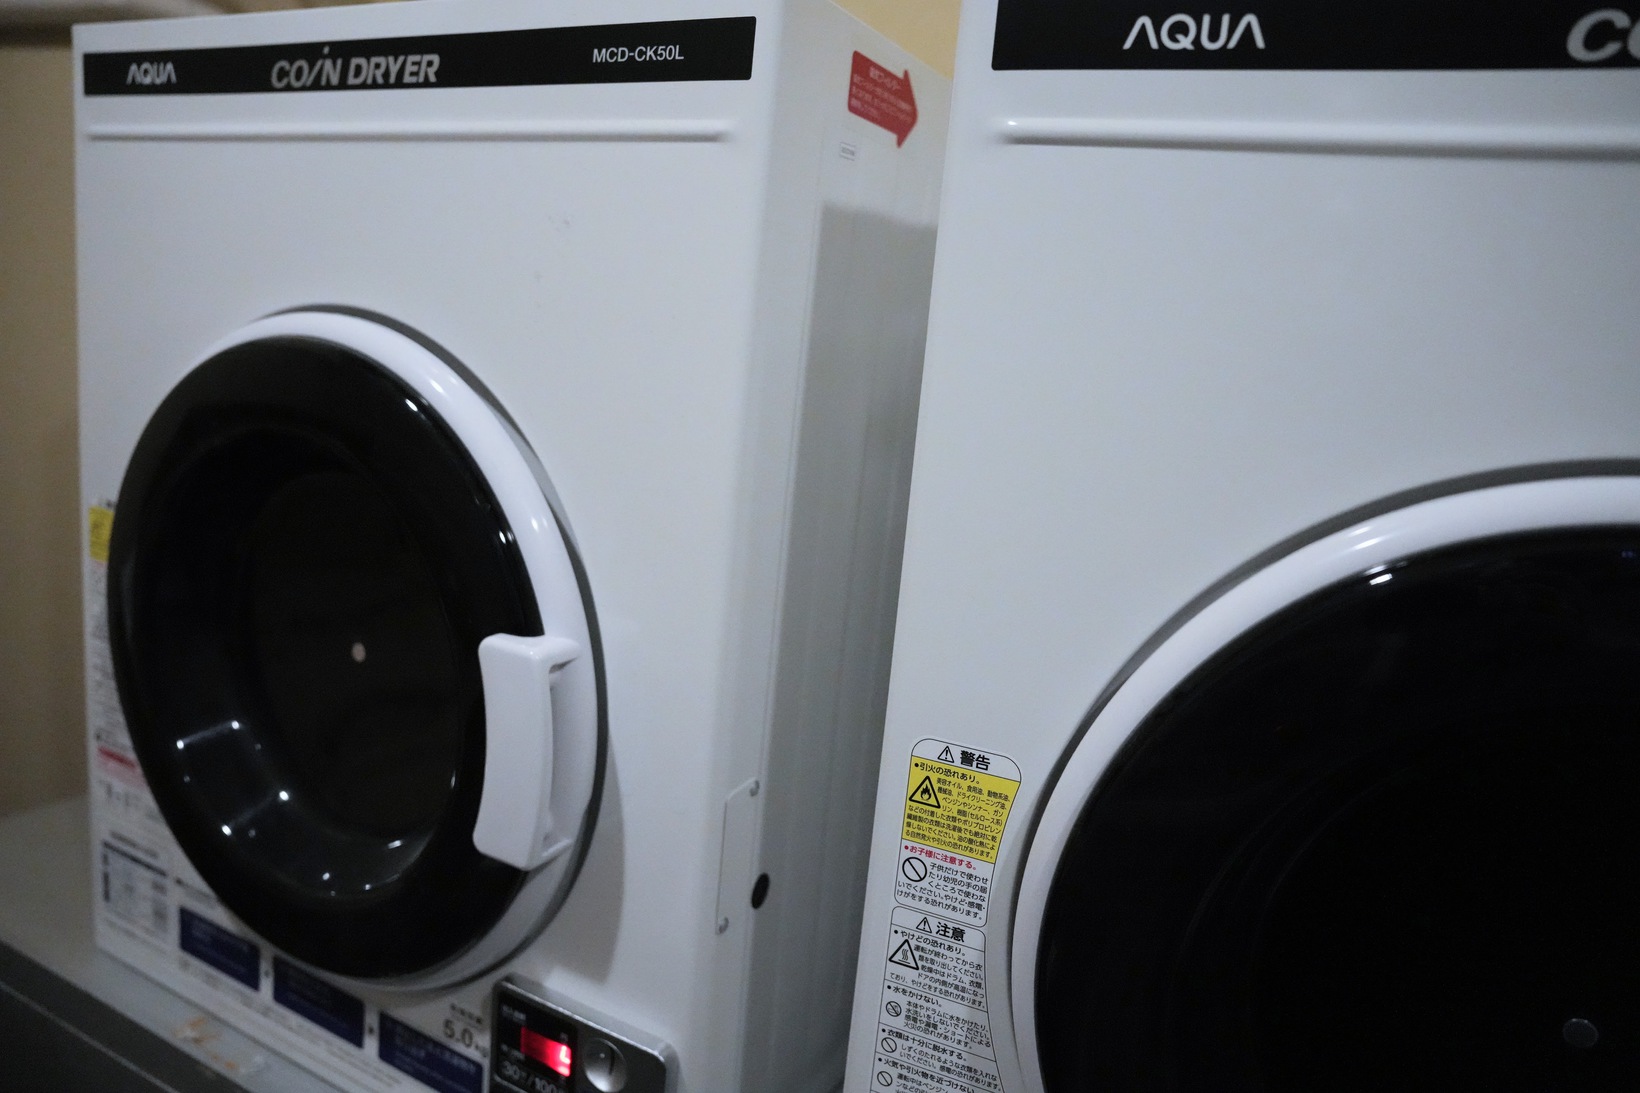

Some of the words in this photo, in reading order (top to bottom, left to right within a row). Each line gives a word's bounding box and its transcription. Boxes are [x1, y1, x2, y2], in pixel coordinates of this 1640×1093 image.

[1122, 13, 1265, 50] AQUA
[1566, 8, 1640, 61] C
[592, 45, 684, 63] MCD-CK50L
[126, 61, 177, 85] AQUA
[270, 45, 342, 89] COIN
[347, 54, 440, 85] DRYER
[960, 750, 990, 771] 警告
[919, 761, 980, 785] 引火の恐れあり。
[909, 845, 976, 870] お子様に注意する。
[928, 871, 988, 895] たり幼児の手の届
[929, 861, 988, 885] 子供だけで使わせ
[900, 930, 965, 957] やけどの恐れあり。
[935, 921, 966, 942] 注意
